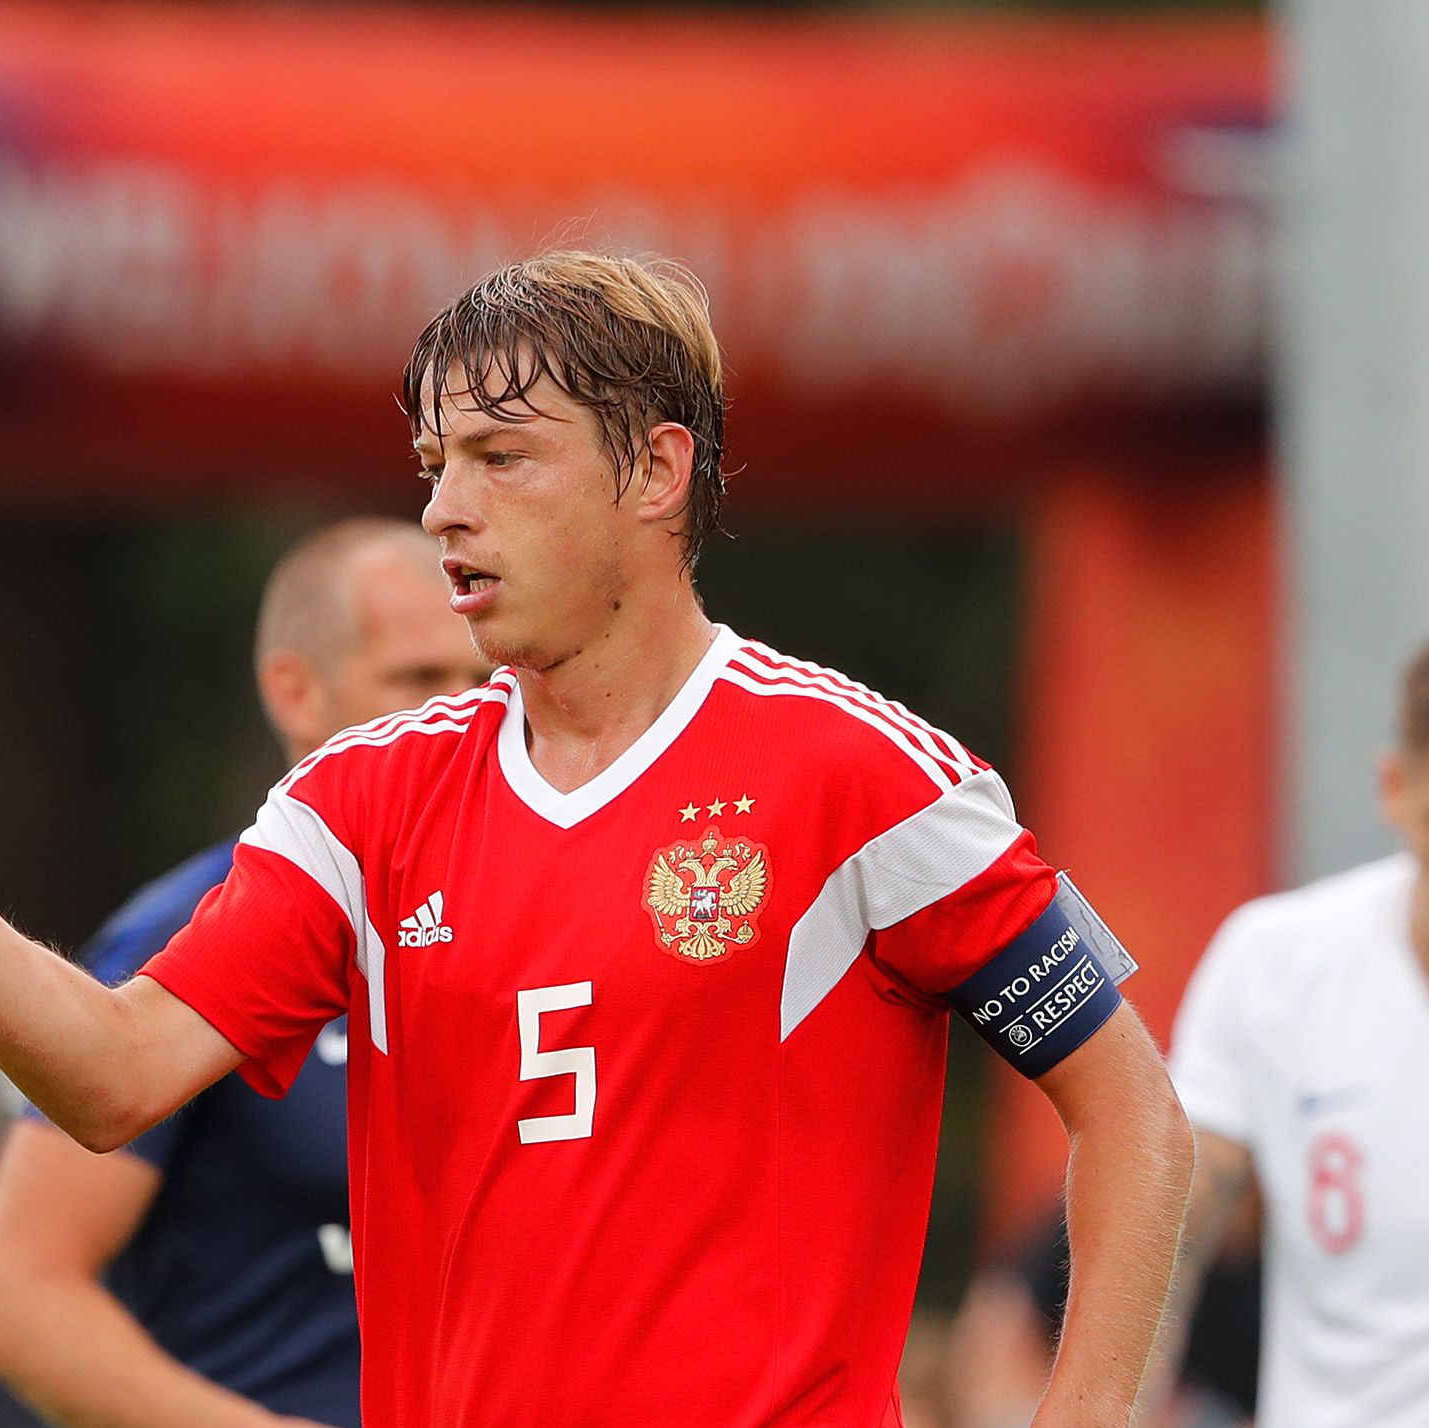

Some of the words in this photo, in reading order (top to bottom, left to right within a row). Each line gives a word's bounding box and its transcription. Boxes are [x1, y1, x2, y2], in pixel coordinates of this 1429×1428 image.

[971, 998, 1003, 1025] NO
[999, 976, 1031, 1004] TO
[1028, 925, 1081, 983] RACISM
[1031, 960, 1100, 1030] RESPECT
[517, 980, 596, 1145] 5
